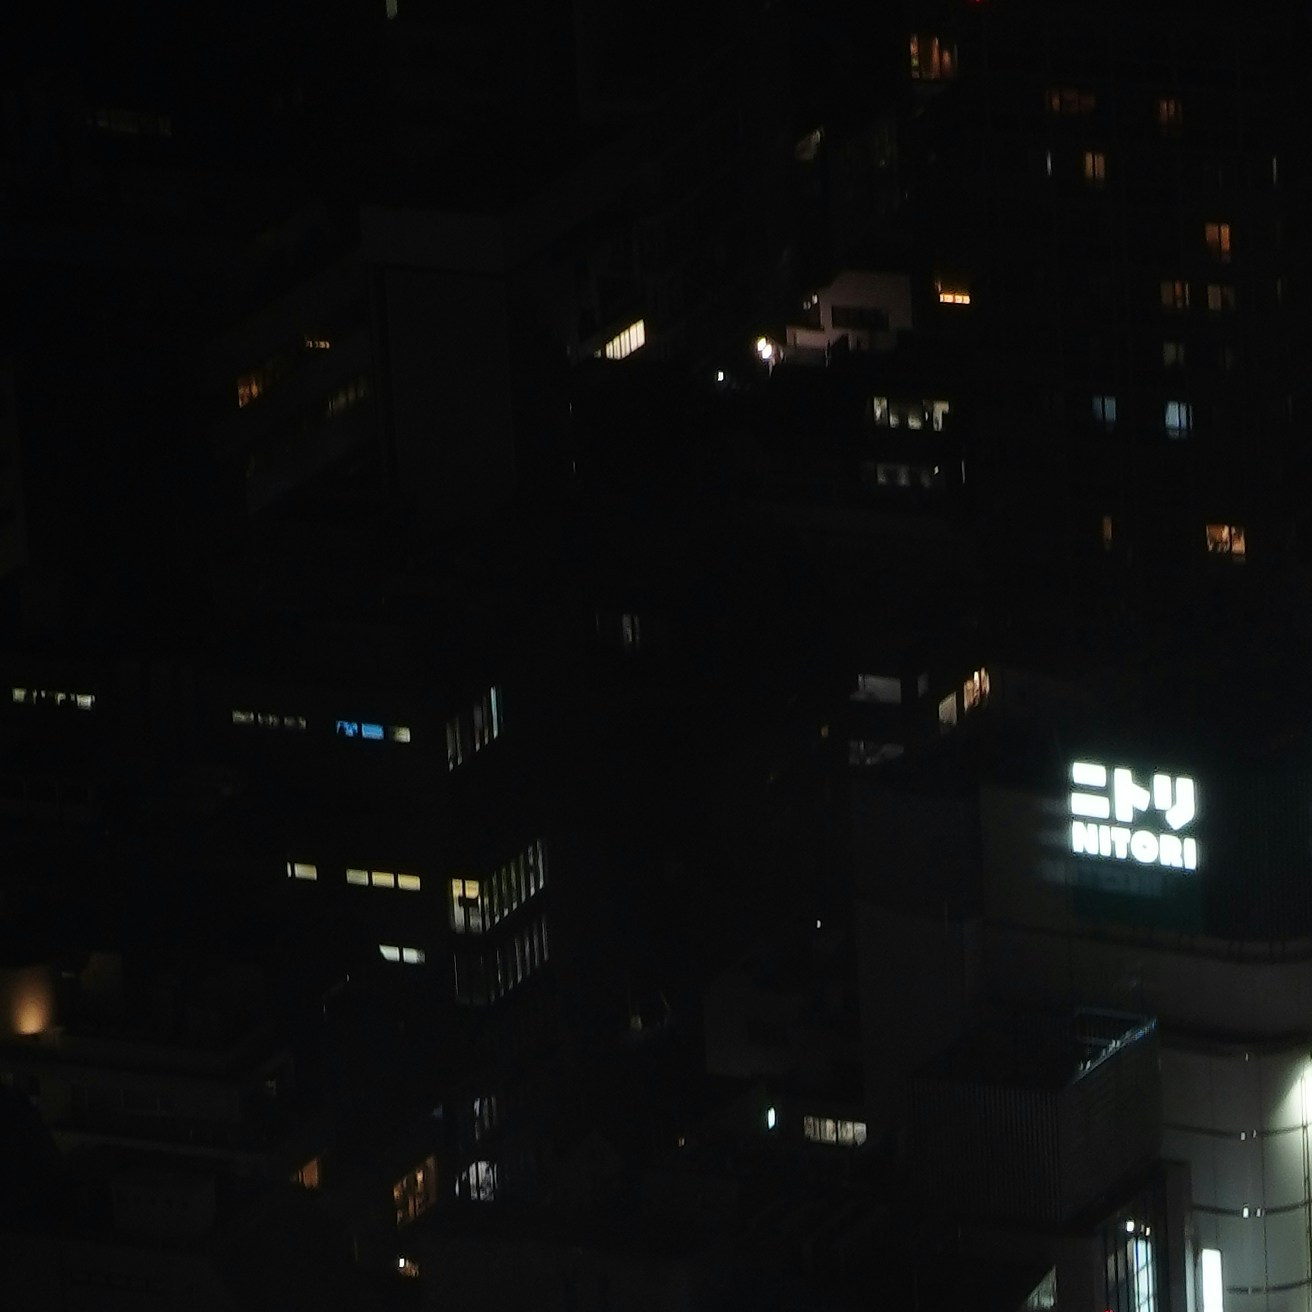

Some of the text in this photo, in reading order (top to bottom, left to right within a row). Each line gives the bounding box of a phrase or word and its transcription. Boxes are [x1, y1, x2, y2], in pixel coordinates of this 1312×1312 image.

[1070, 761, 1195, 830] ニトリ
[1071, 822, 1197, 870] NITORI
